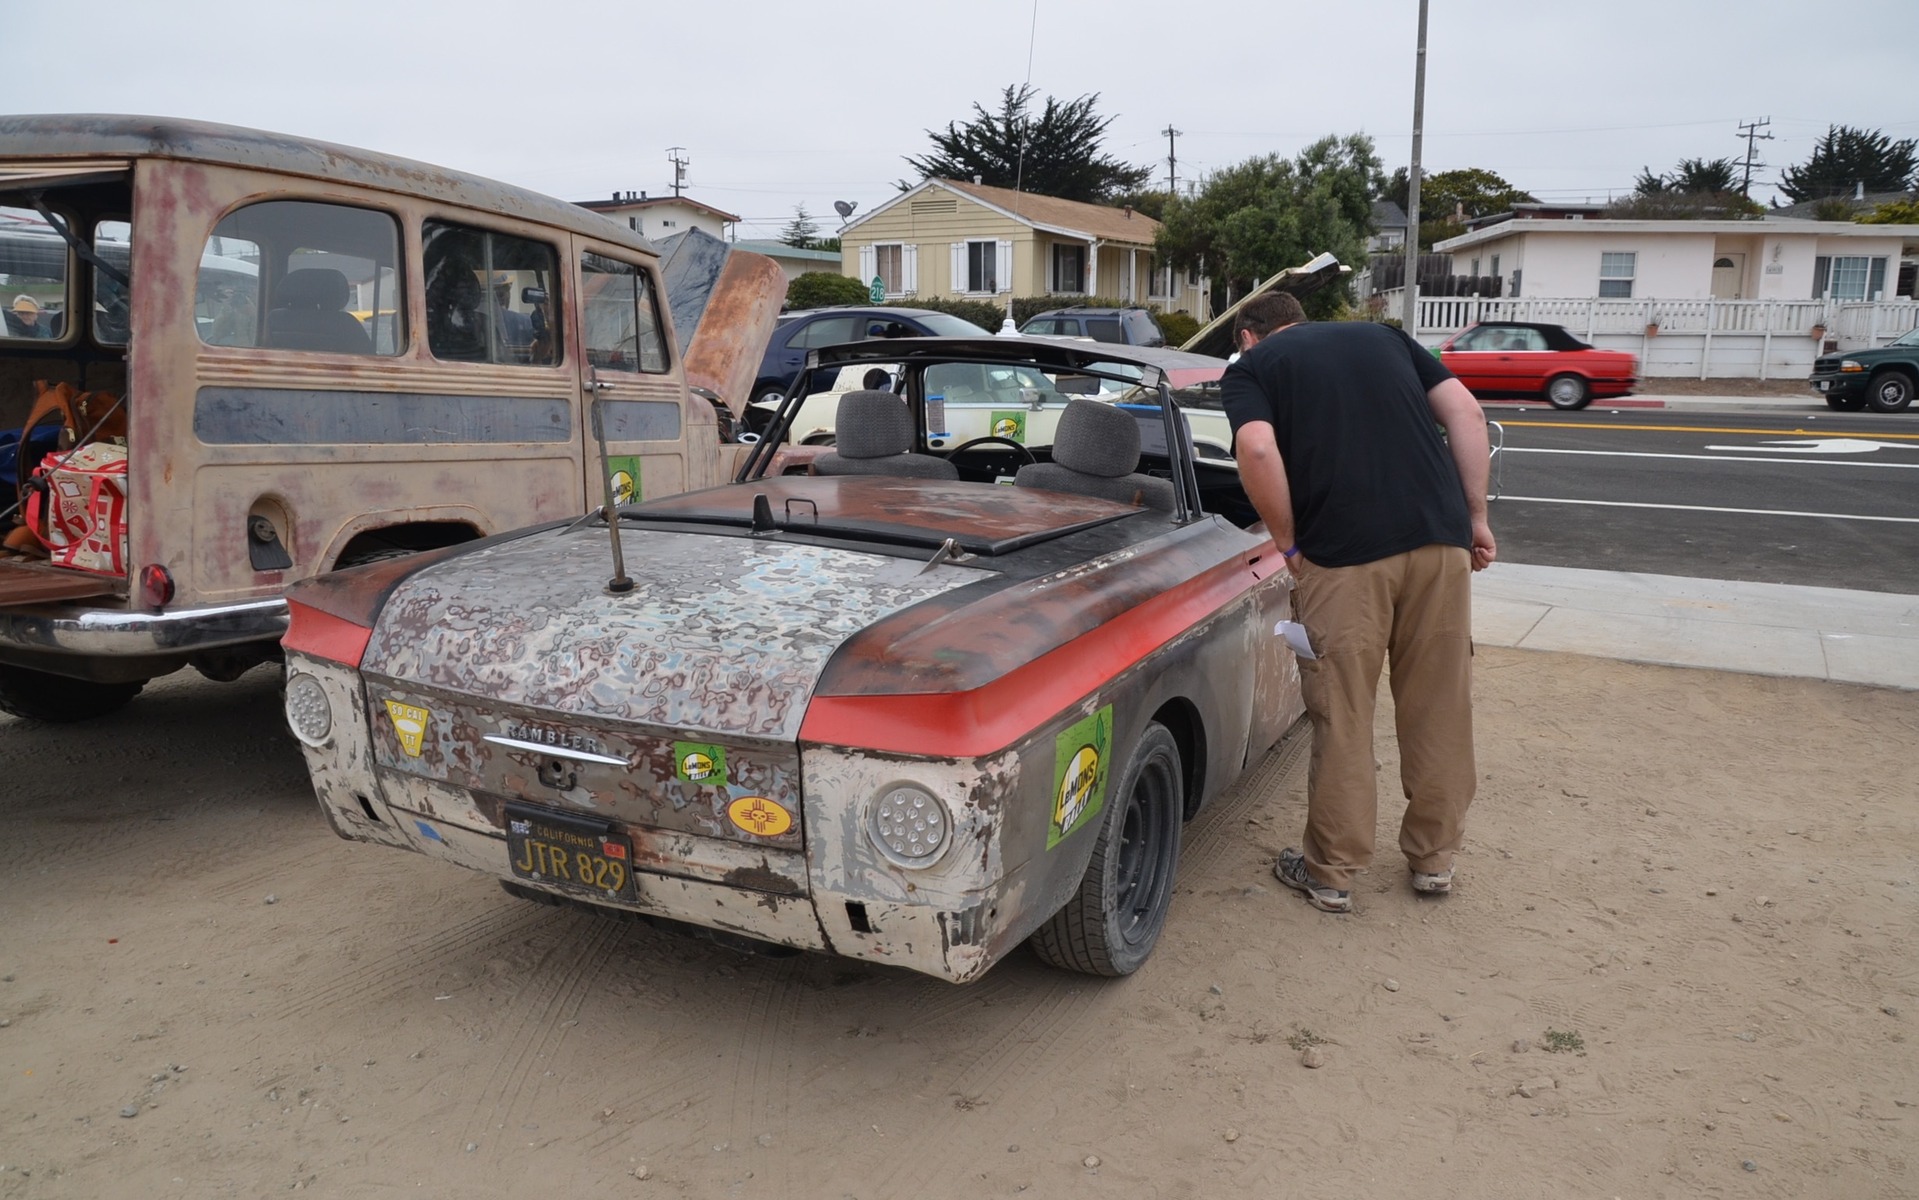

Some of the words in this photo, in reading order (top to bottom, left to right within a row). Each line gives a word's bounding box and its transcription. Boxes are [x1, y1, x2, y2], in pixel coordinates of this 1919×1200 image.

[870, 286, 884, 300] 218
[392, 704, 403, 717] SO
[406, 708, 423, 722] CAL
[404, 734, 416, 746] TT
[507, 724, 597, 753] RAMBLER
[684, 761, 711, 771] LeMONS
[1059, 760, 1096, 811] LeMONS
[1062, 784, 1092, 834] RALLY
[536, 826, 595, 849] CALIFORNIA
[516, 838, 571, 880] JTR
[576, 853, 626, 891] 829
